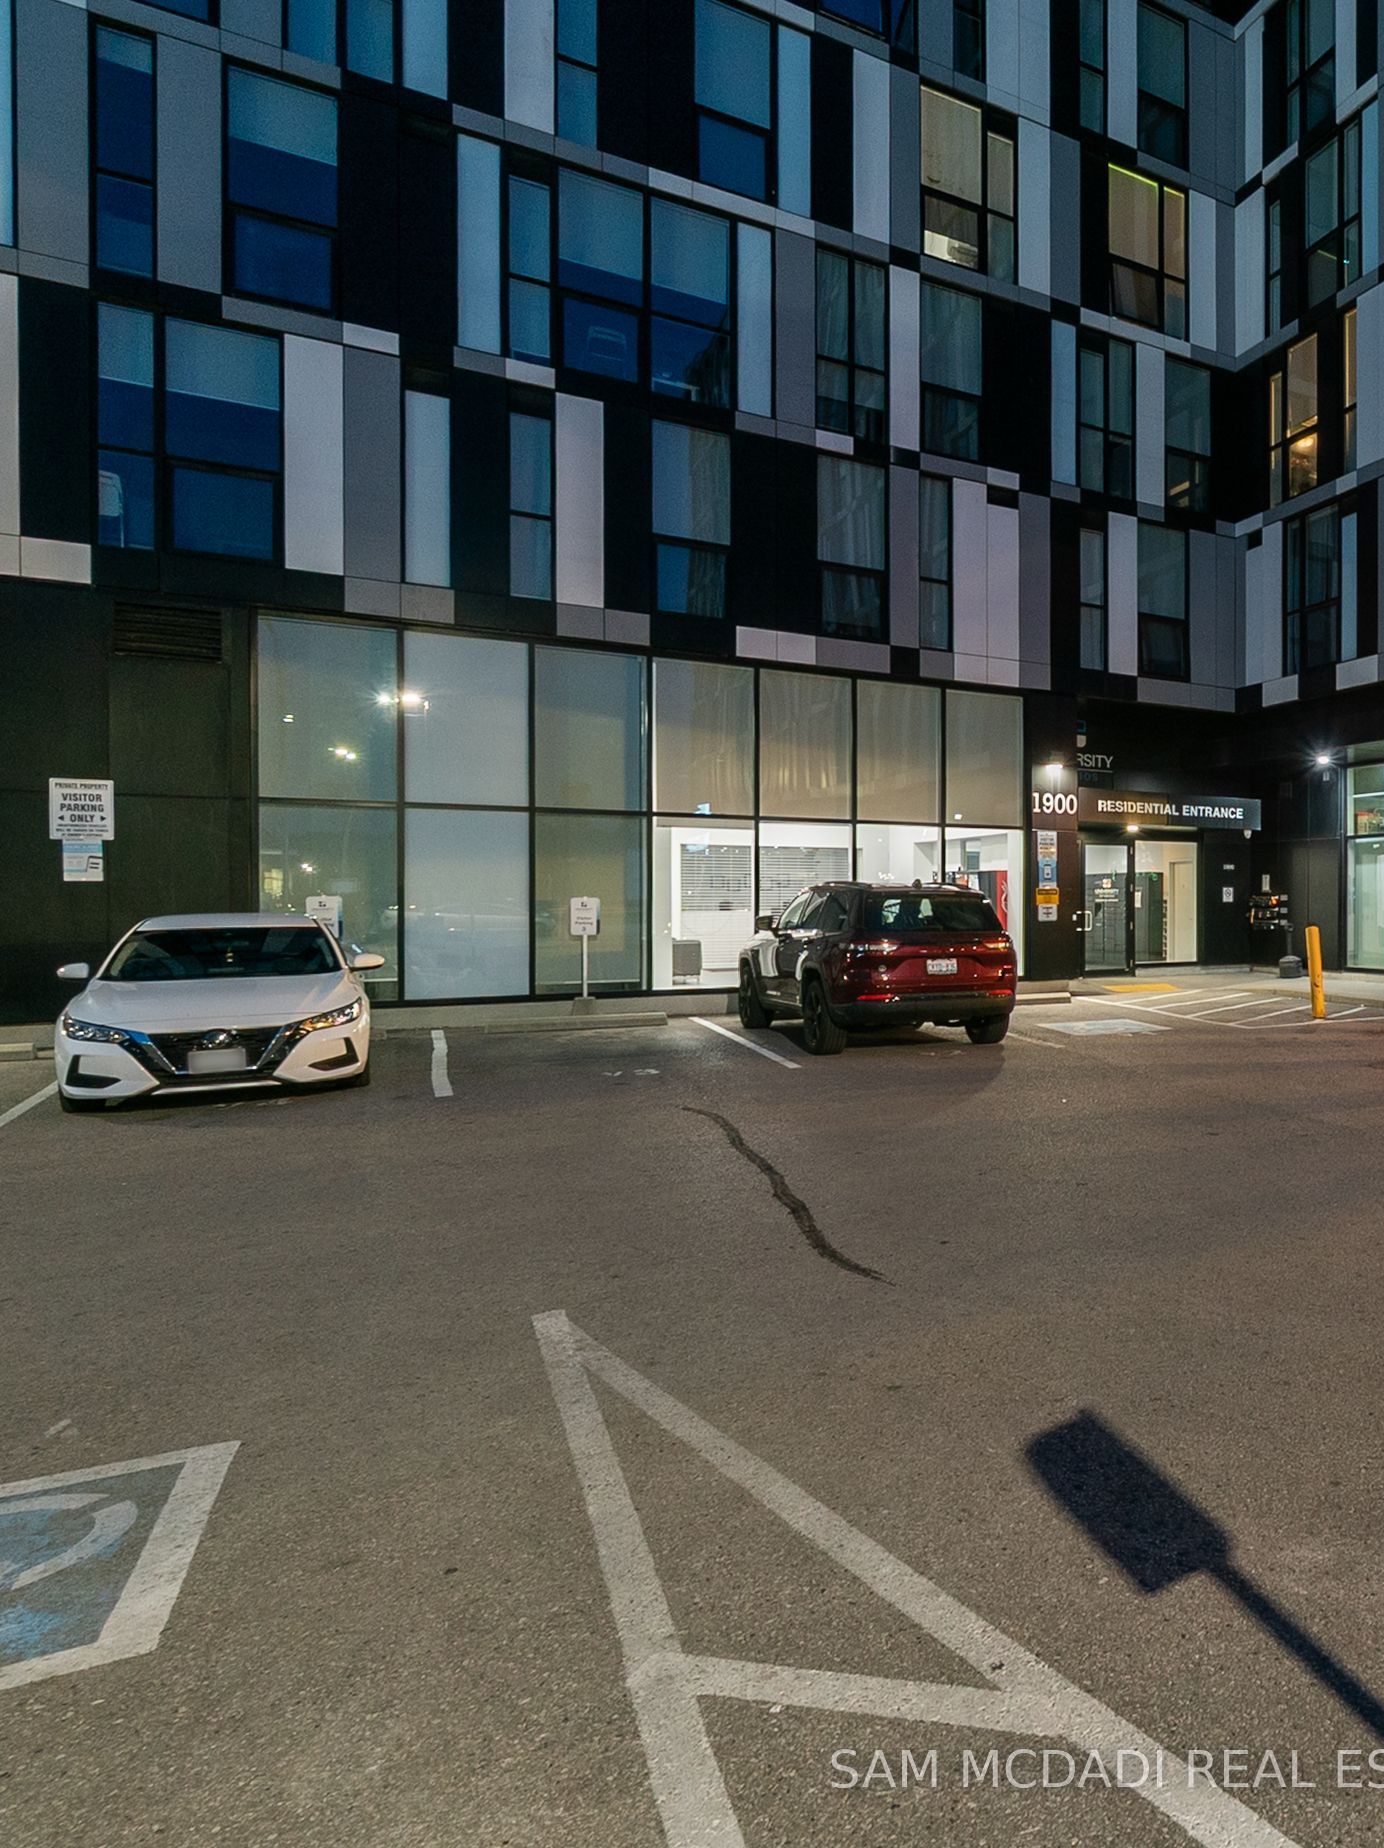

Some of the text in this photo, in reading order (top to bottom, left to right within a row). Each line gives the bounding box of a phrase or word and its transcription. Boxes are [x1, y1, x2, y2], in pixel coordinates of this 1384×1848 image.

[61, 792, 103, 802] VISITOR
[60, 803, 105, 812] PARKING
[1032, 792, 1078, 815] 1900
[1098, 799, 1244, 819] RESIDENTIAL ENTRANCE
[70, 814, 95, 823] ONLY
